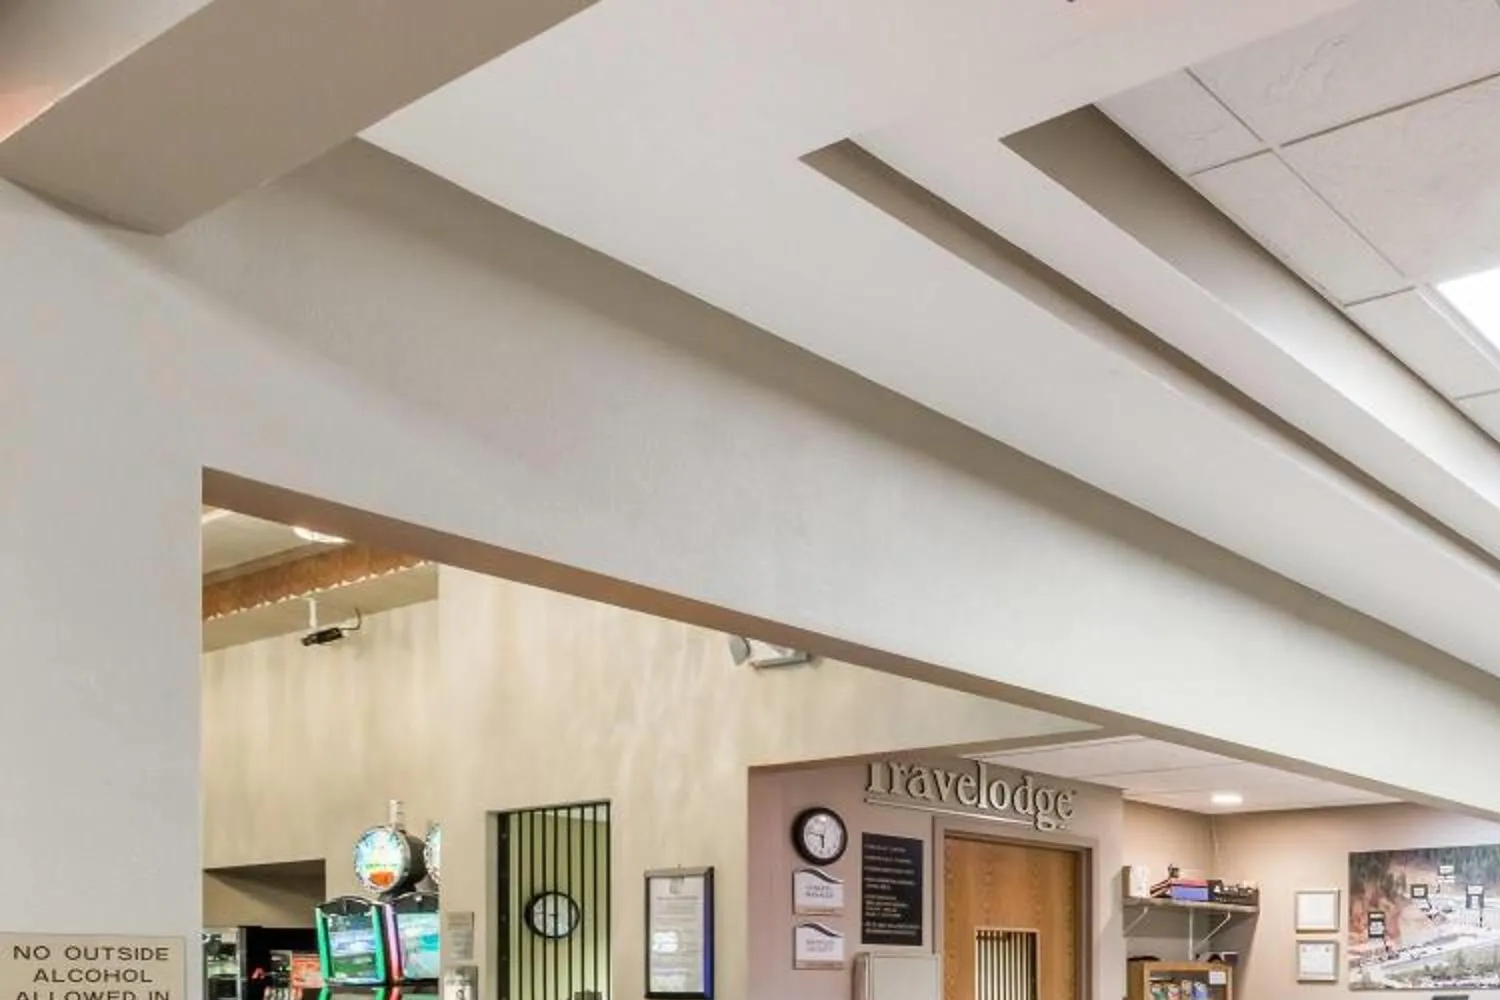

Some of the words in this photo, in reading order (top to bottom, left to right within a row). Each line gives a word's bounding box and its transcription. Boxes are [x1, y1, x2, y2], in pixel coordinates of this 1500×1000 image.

[13, 945, 51, 960] NO
[64, 946, 170, 961] OUTSIDE
[33, 968, 153, 983] ALCOHOL
